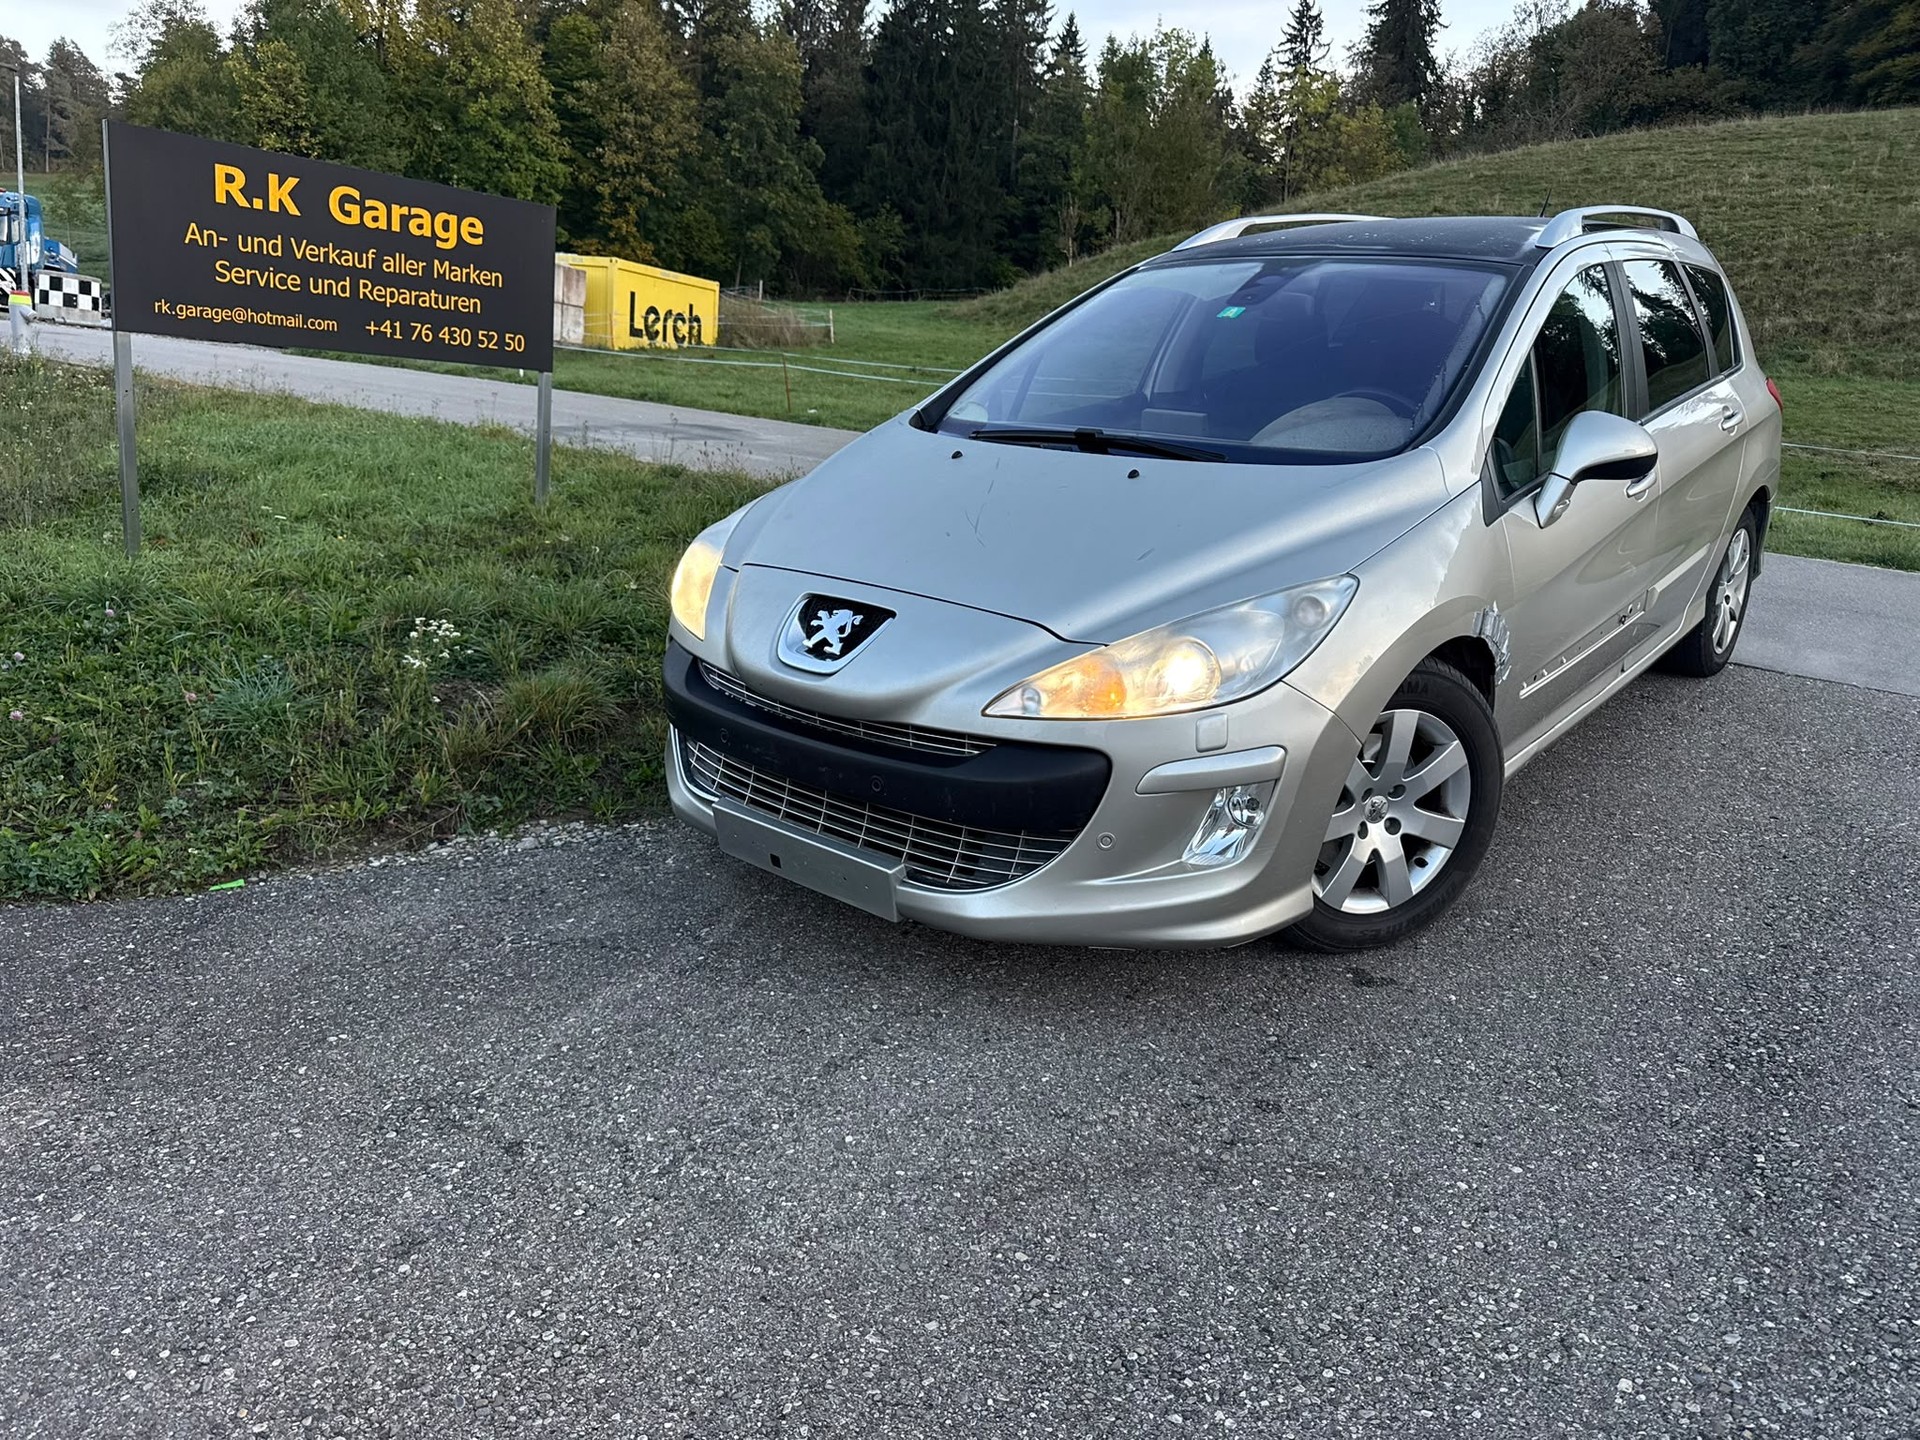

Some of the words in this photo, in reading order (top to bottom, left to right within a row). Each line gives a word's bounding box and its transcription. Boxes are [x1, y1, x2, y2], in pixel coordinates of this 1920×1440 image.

[214, 163, 302, 217] R.K
[328, 185, 485, 250] Garage
[184, 222, 228, 248] An-
[237, 233, 282, 257] und
[290, 238, 377, 270] Verkauf
[382, 252, 427, 278] aller
[433, 258, 504, 288] Marken
[214, 259, 302, 291] Service
[309, 268, 351, 297] und
[359, 279, 482, 314] Reparaturen
[153, 299, 339, 333] rk.garage@hotmail.com
[365, 320, 403, 339] +41
[410, 322, 434, 344] 76
[439, 325, 472, 347] 430
[477, 329, 499, 350] 52
[504, 333, 526, 353] 50
[628, 290, 703, 345] Lerch
